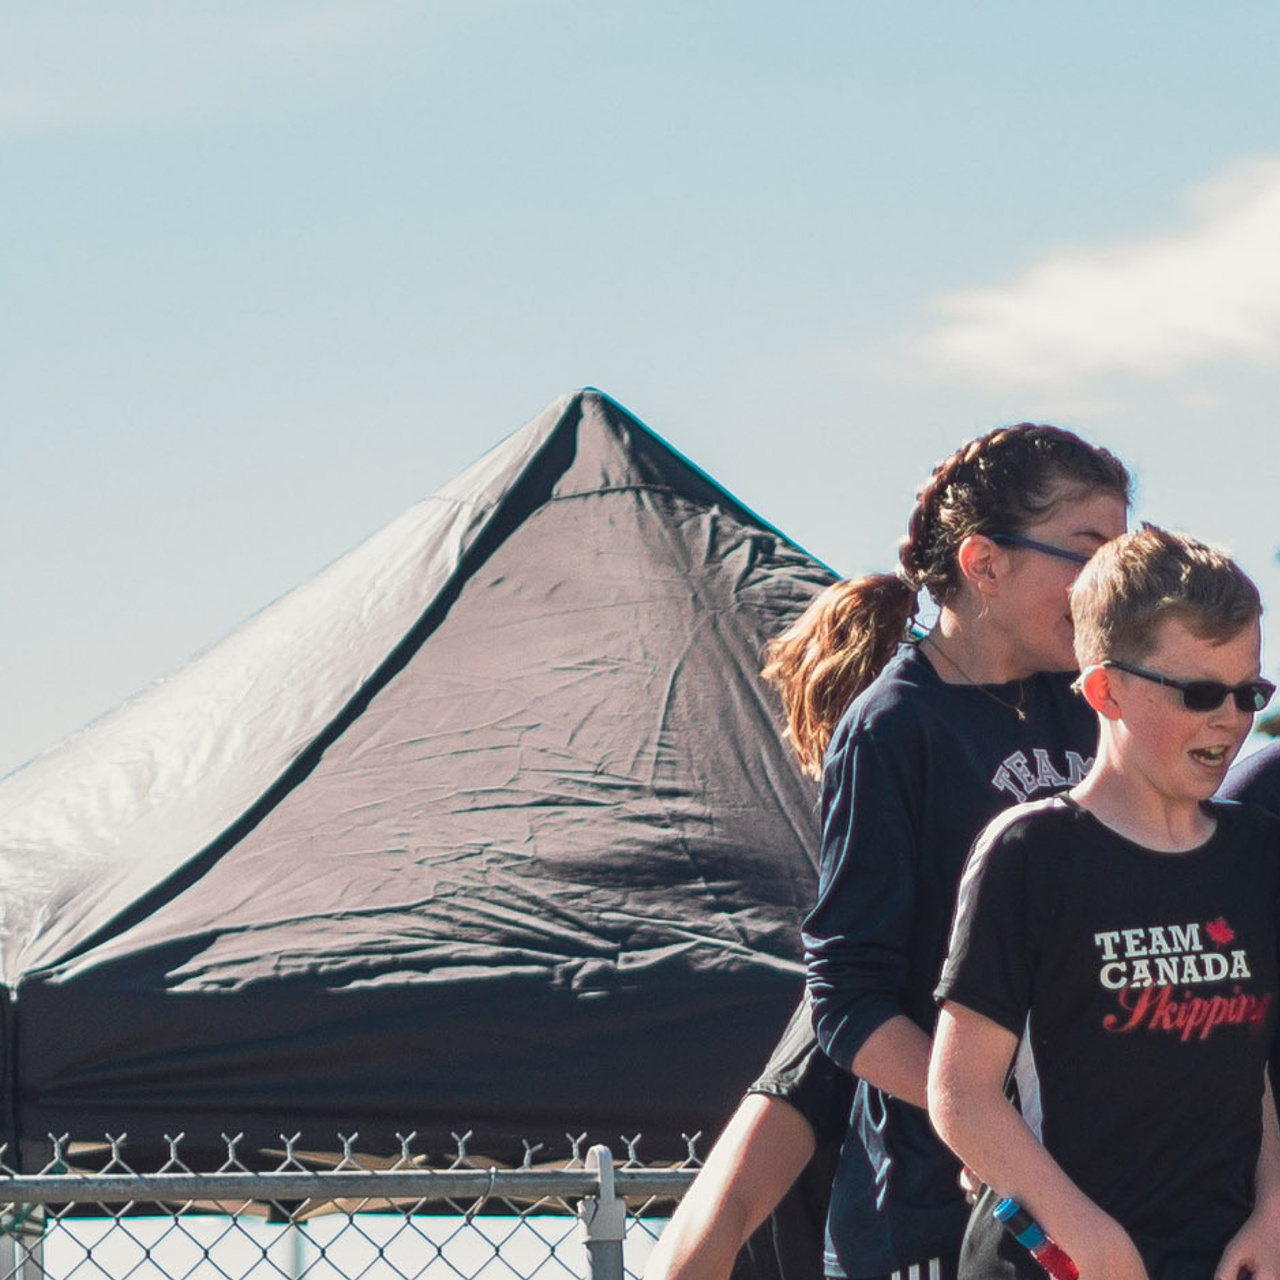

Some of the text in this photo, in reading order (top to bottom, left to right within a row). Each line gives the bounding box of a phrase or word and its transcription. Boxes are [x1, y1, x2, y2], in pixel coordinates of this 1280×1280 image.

[991, 748, 1096, 803] TEAM
[1094, 923, 1203, 960] TEAM
[1100, 949, 1251, 989] CANADA
